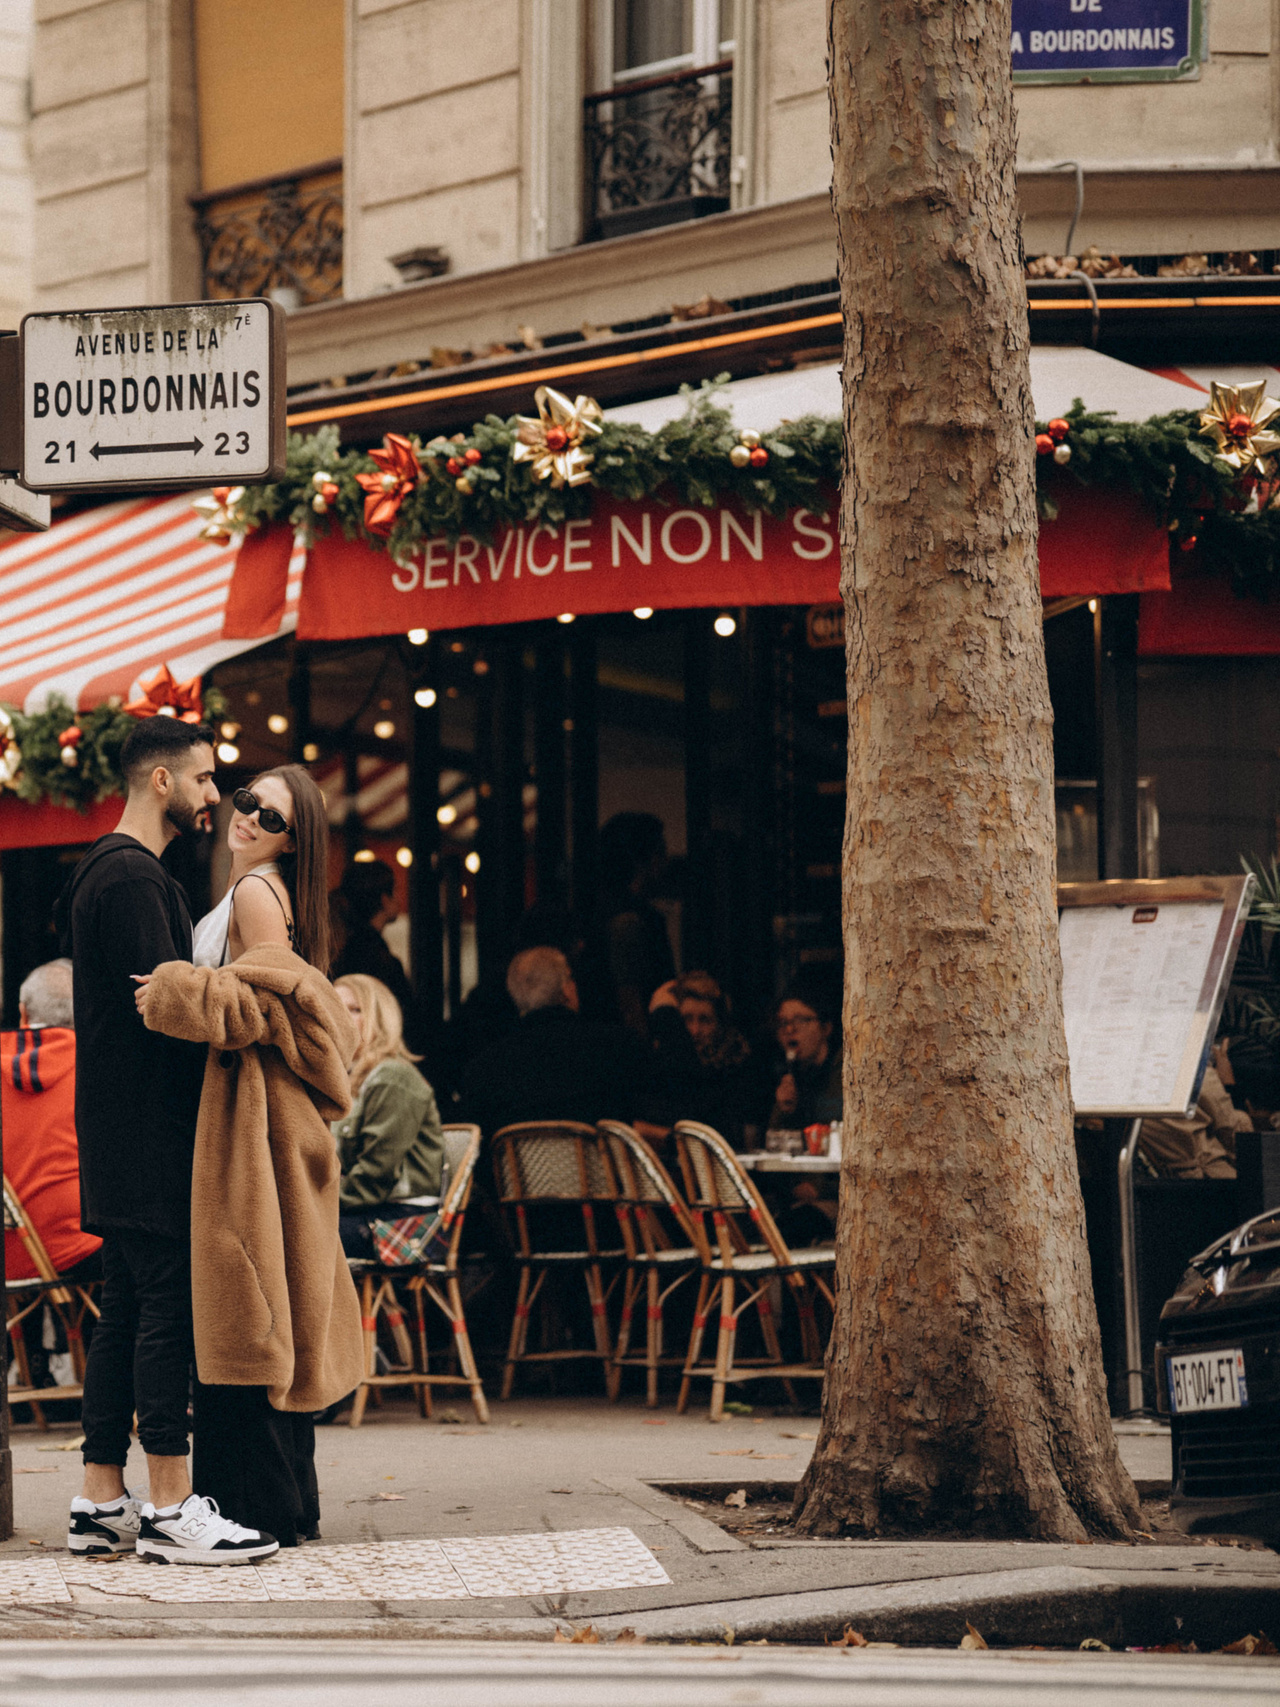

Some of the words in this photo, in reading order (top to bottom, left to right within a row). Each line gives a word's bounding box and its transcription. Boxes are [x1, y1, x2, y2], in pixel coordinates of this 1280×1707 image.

[1070, 0, 1103, 12] DE
[1011, 31, 1024, 53] A
[1030, 27, 1175, 53] BOURDONNAIS
[75, 331, 154, 357] AVENUE
[163, 329, 187, 352] DE
[196, 328, 219, 350] LA
[33, 370, 261, 418] BOURDONNAIS
[44, 440, 76, 464] 21
[214, 431, 250, 455] 23
[391, 518, 593, 592] SERVICE
[611, 509, 763, 568] NON
[791, 508, 834, 560] S
[1174, 1358, 1235, 1406] BT-004-FT
